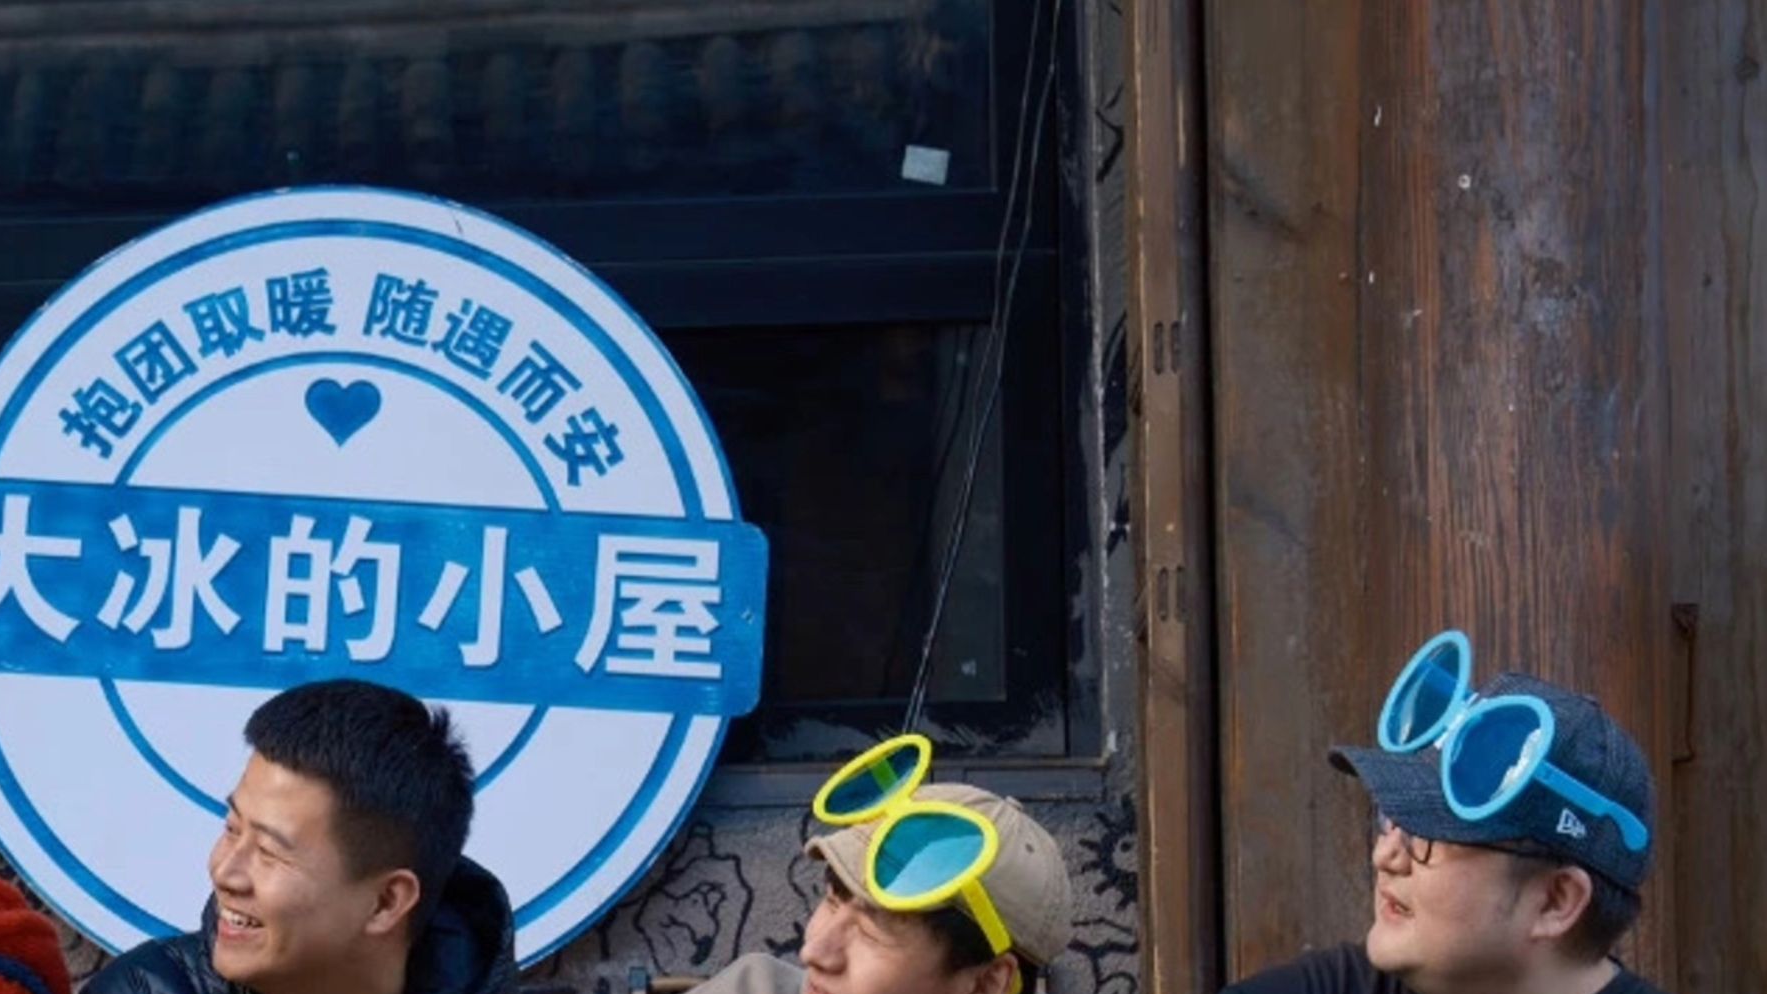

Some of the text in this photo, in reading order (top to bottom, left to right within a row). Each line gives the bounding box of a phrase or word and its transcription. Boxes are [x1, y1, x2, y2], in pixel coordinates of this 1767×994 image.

[58, 267, 626, 488] 抱团取暖 随遇而安
